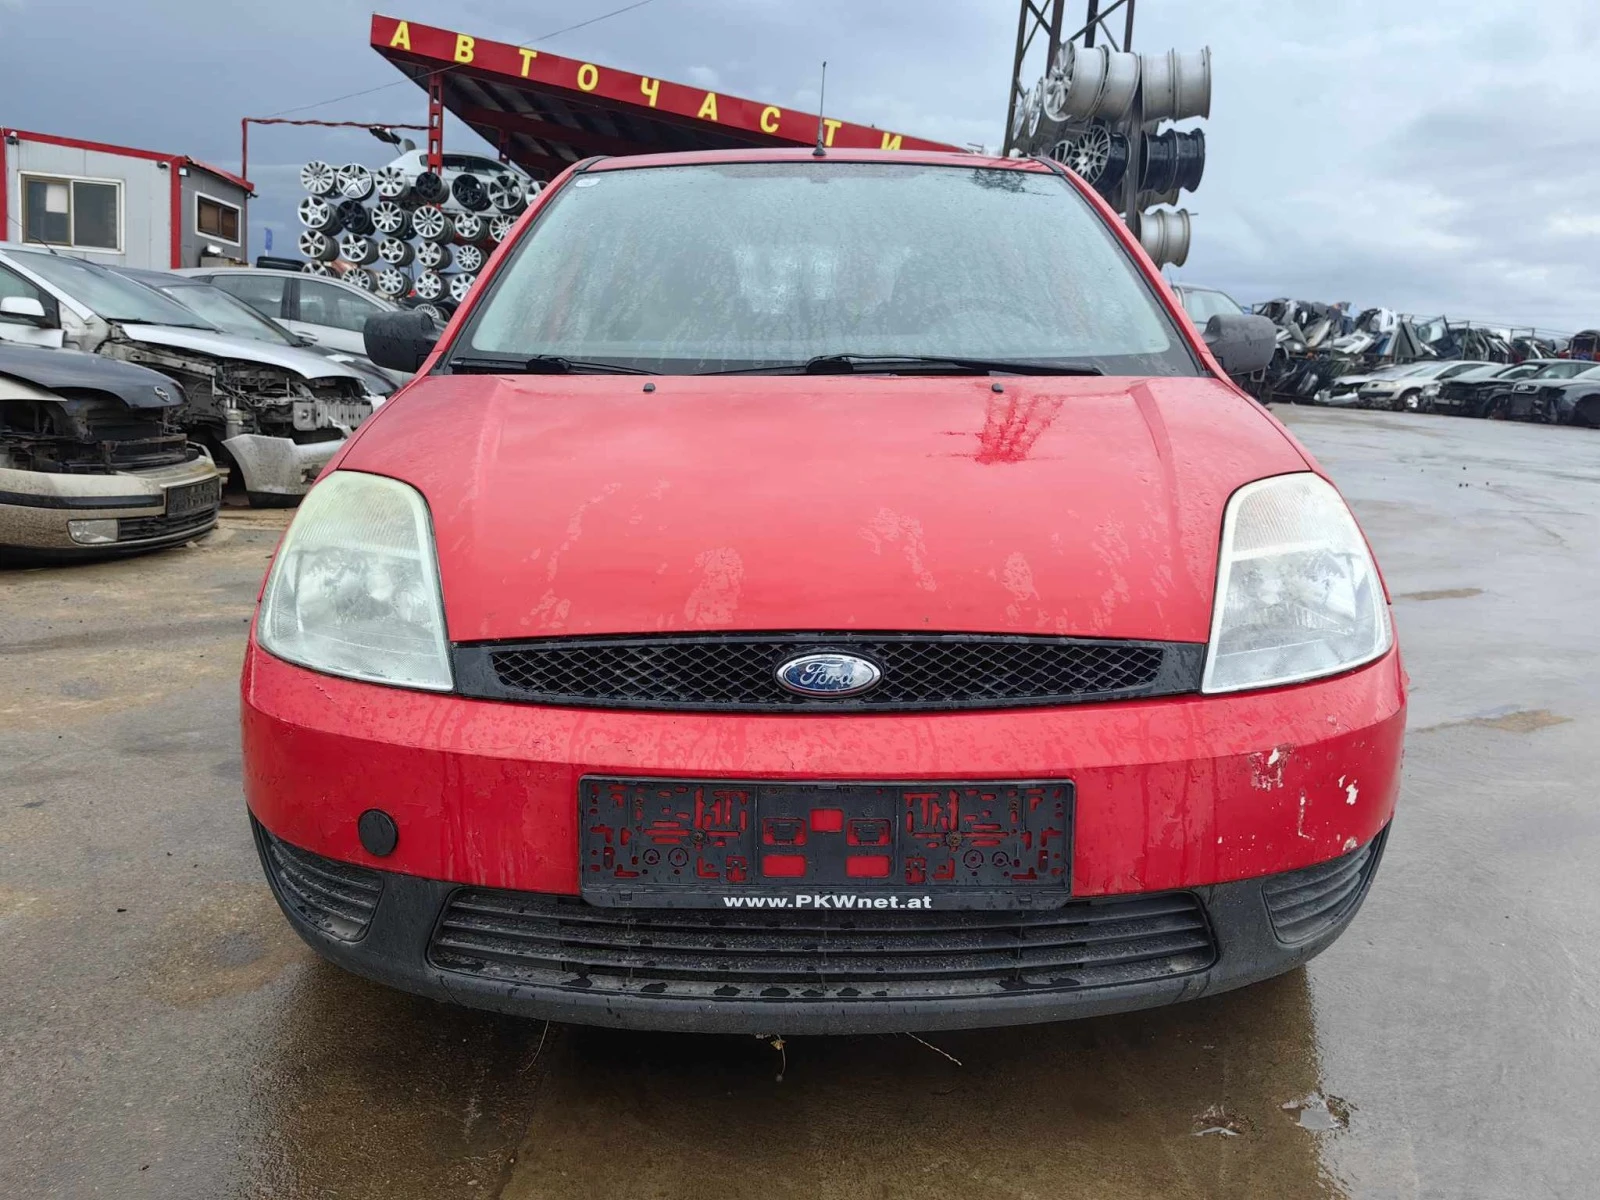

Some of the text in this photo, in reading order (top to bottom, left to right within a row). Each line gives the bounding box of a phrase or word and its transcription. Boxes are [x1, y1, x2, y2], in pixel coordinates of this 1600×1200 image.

[390, 21, 903, 150] АВТОЧАСТИ
[799, 662, 856, 686] Ford
[723, 894, 932, 909] www.PKWnet.at
